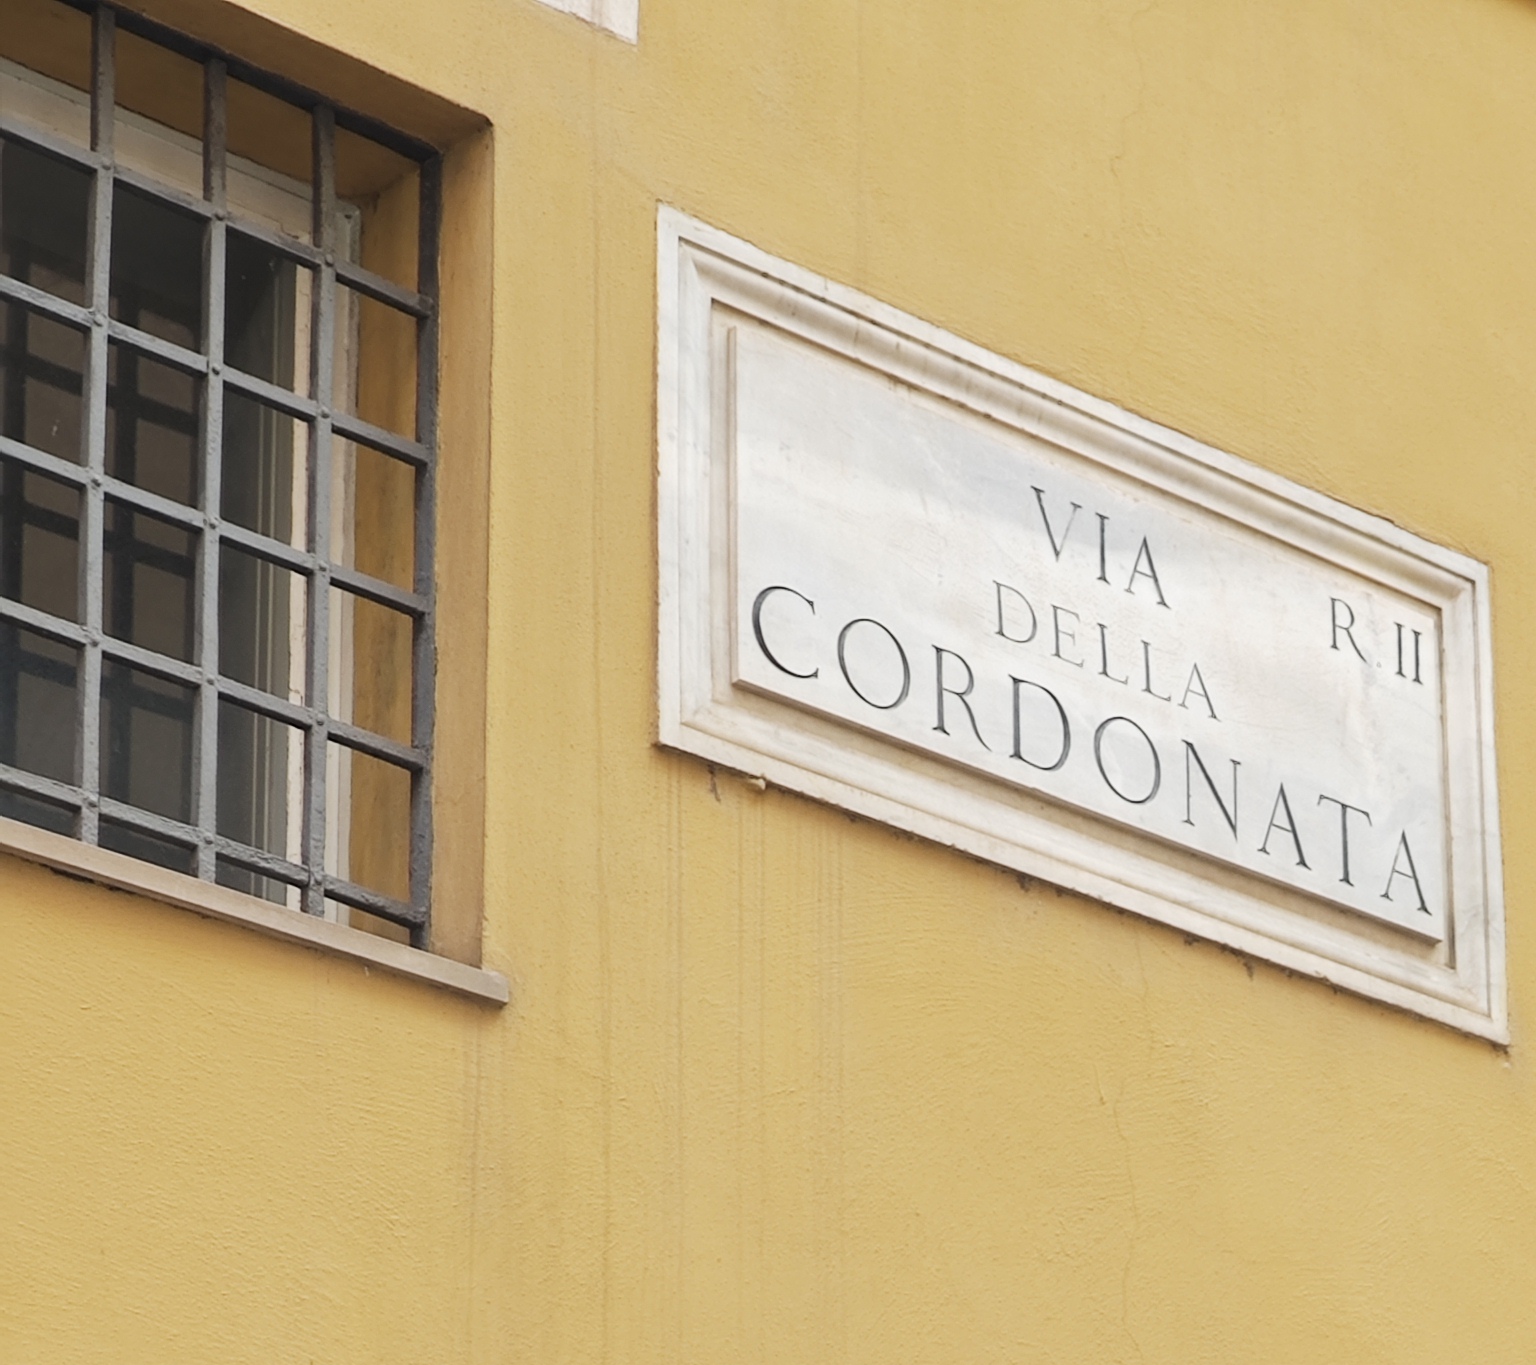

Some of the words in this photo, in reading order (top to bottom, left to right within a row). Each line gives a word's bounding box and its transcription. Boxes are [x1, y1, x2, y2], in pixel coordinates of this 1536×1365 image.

[1030, 486, 1170, 608] VIA
[993, 580, 1221, 721] DELLA
[752, 585, 1432, 915] CORDONATA
